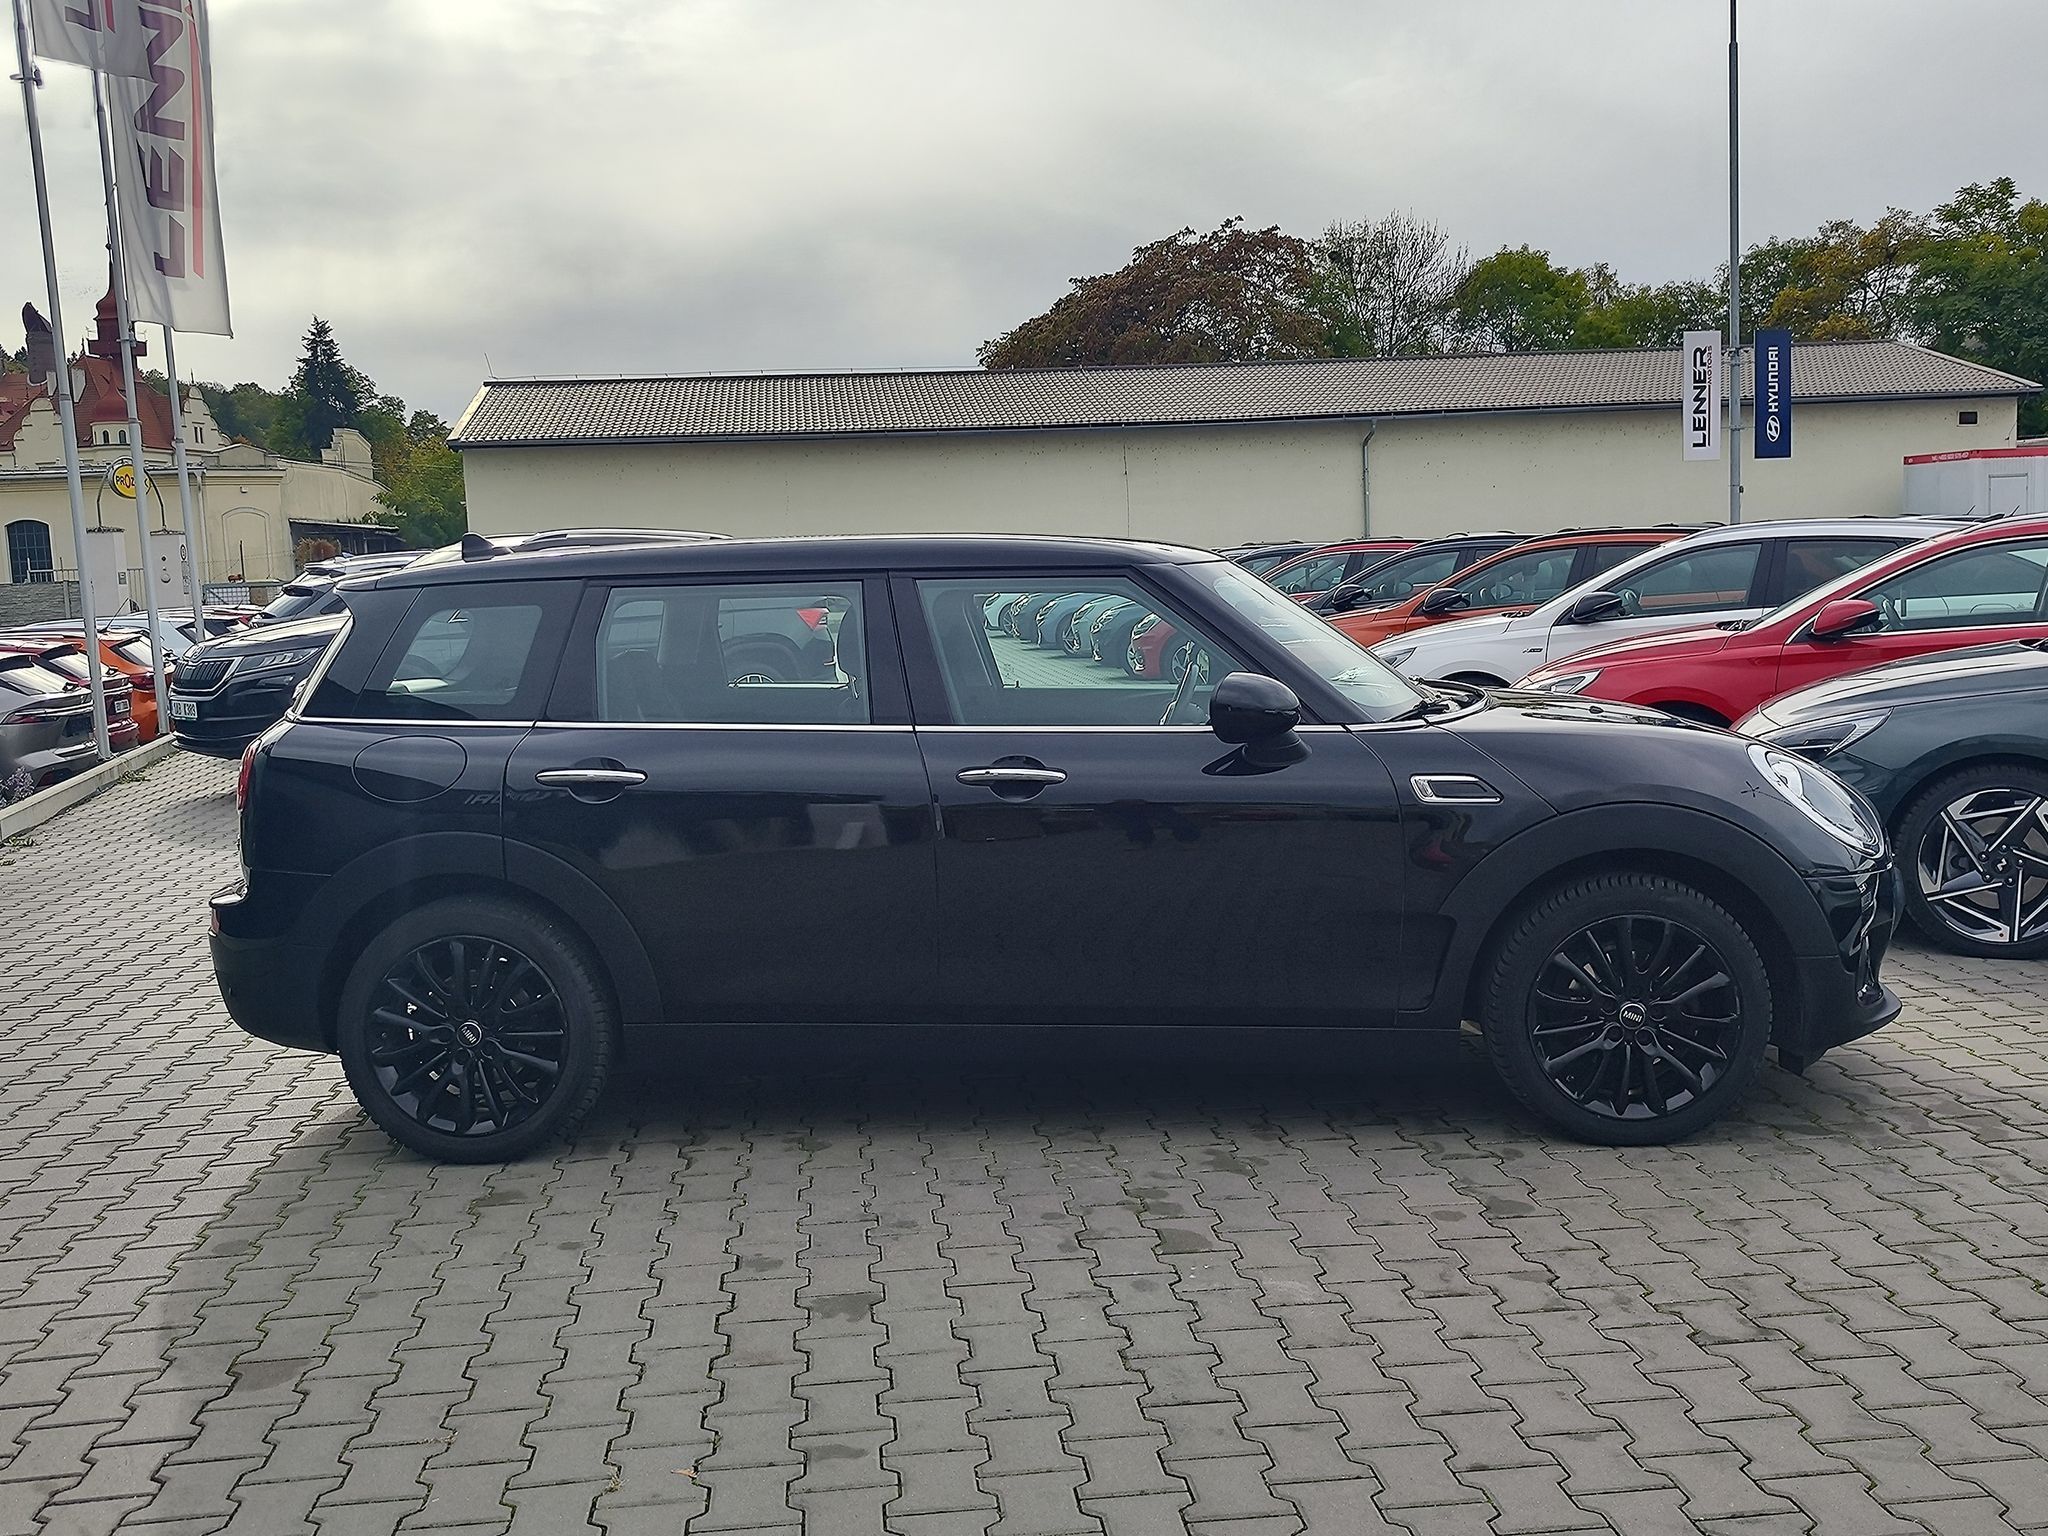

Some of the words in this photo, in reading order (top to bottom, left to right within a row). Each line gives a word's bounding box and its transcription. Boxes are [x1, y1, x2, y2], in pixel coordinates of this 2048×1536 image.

[134, 0, 186, 278] LENN
[1692, 346, 1707, 448] LENNER
[1768, 346, 1779, 412] HYUNDAI
[461, 1026, 477, 1044] MINI
[1622, 1010, 1643, 1023] MINI
